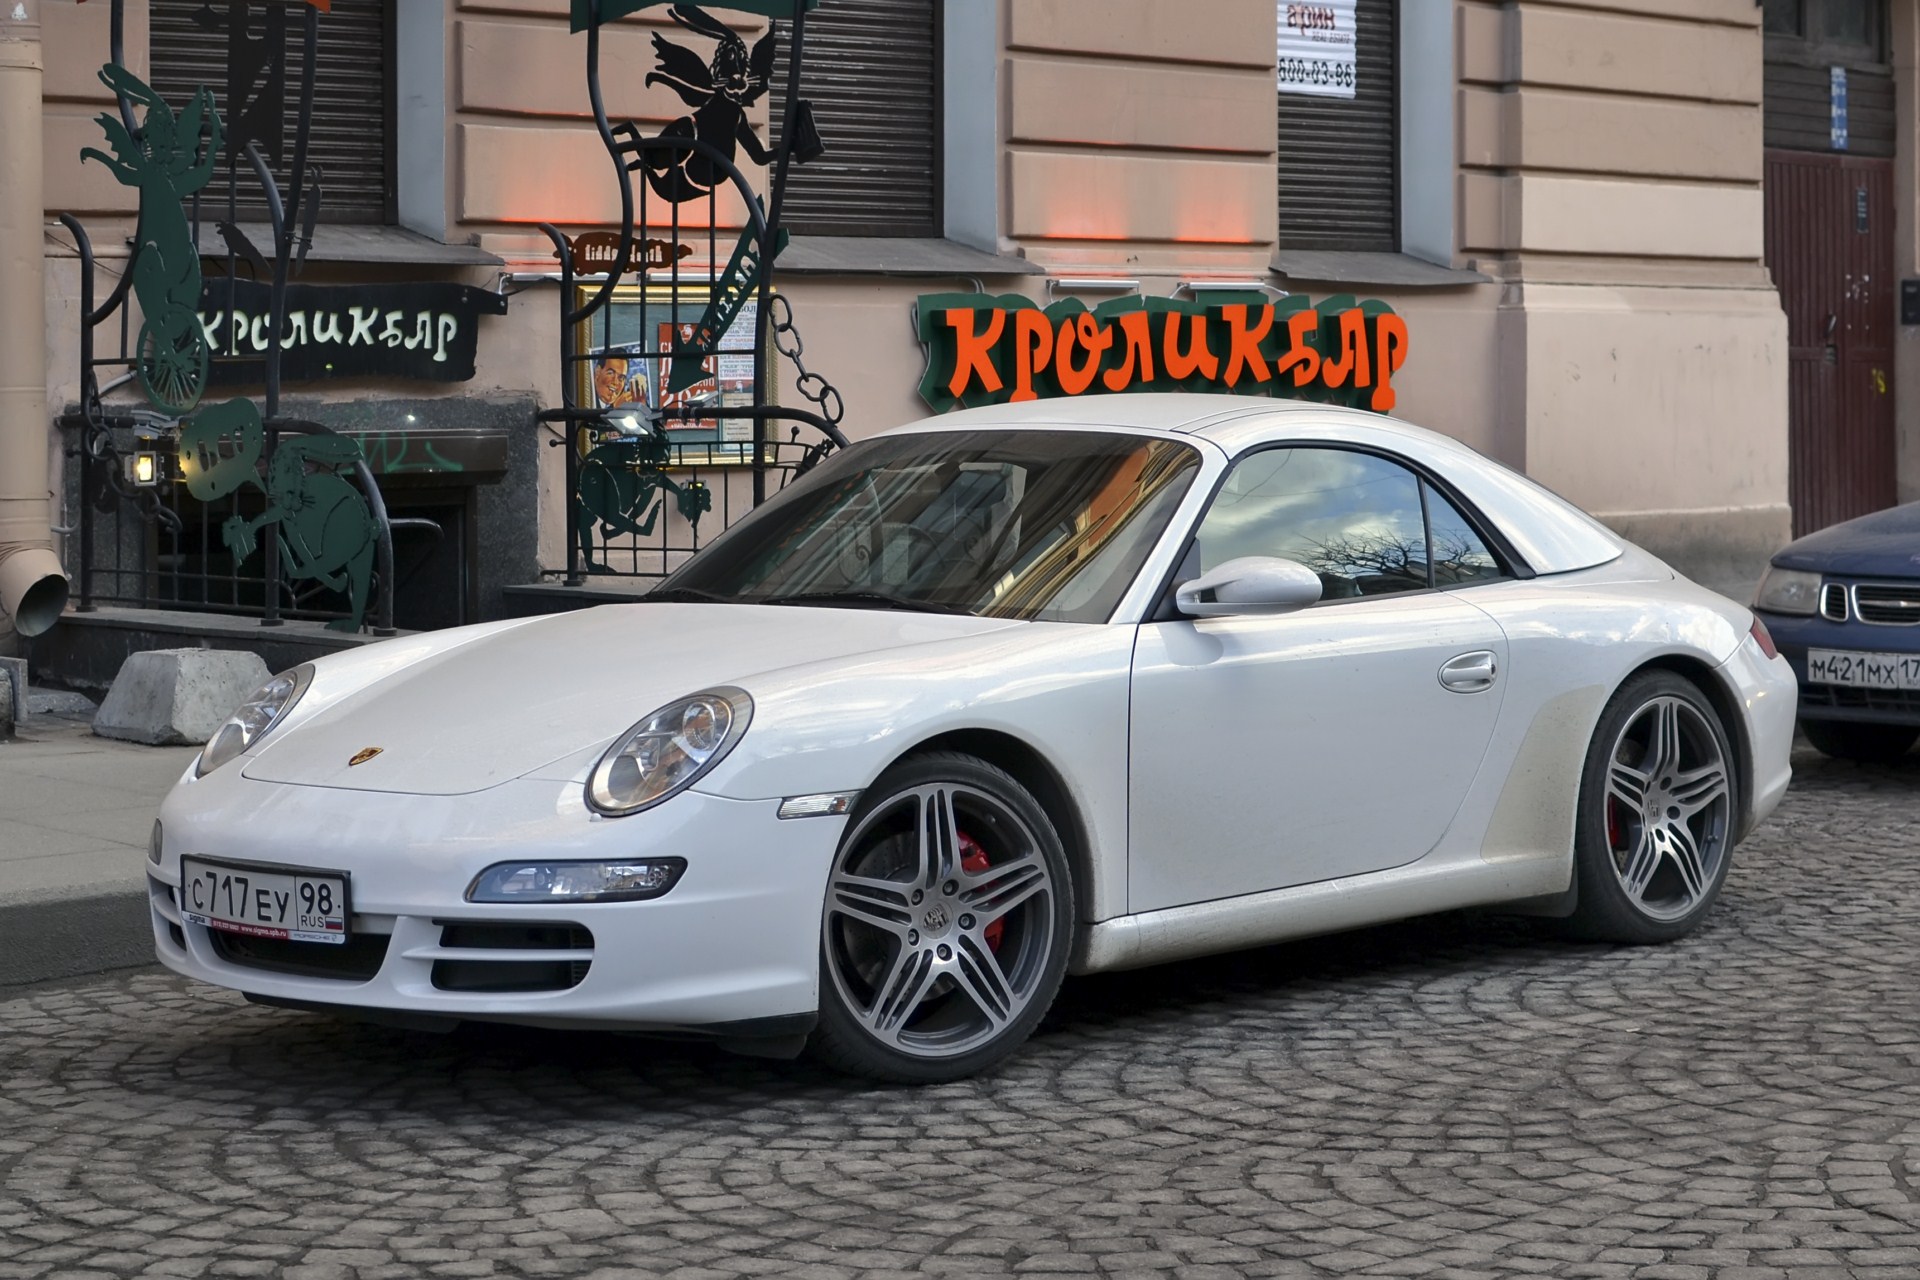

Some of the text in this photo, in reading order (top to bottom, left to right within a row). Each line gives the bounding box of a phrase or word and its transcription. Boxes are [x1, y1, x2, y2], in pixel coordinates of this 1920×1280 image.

[1279, 57, 1353, 87] 600-03-96
[1812, 656, 1895, 685] М421МХ
[192, 871, 333, 923] С717ЕУ 98
[301, 915, 325, 928] RUS
